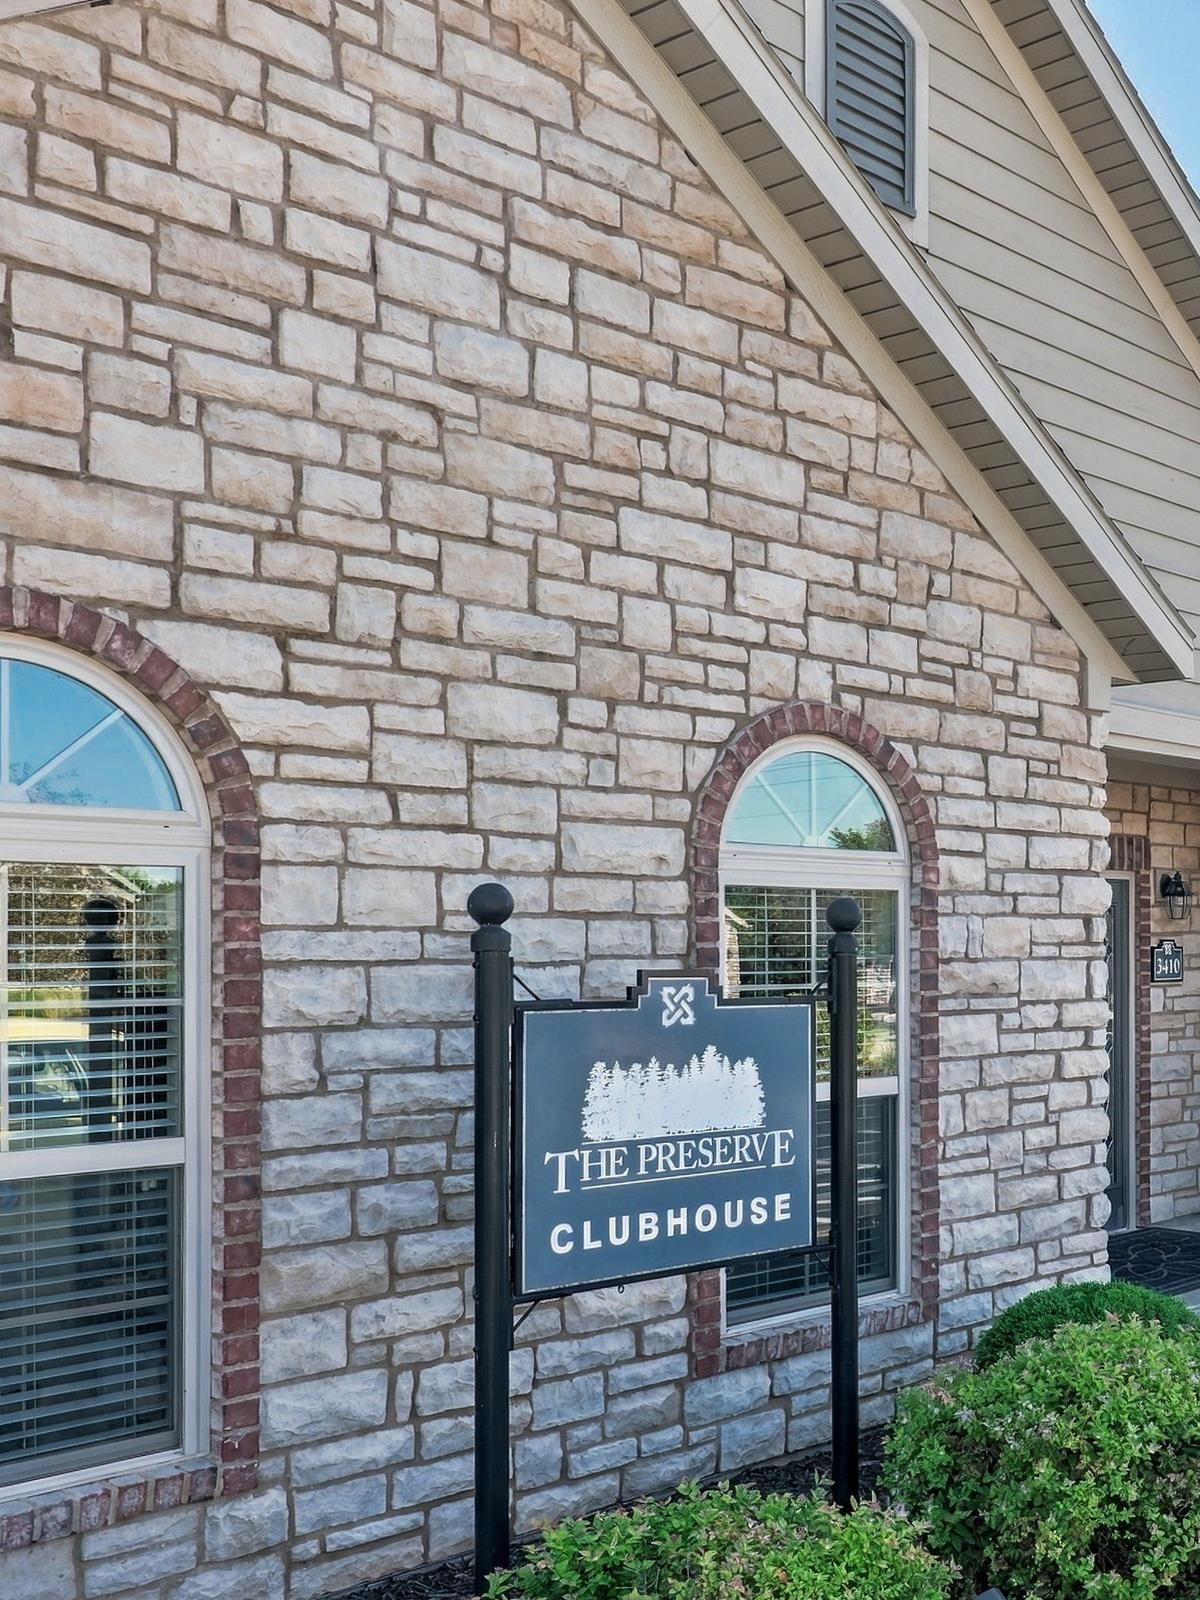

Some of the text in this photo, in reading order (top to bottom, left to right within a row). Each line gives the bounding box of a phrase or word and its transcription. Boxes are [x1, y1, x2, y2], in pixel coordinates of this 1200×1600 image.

[1156, 958, 1180, 974] 3410
[544, 1128, 796, 1194] THE PRESERVE
[550, 1193, 791, 1254] CLUBHOUSE
